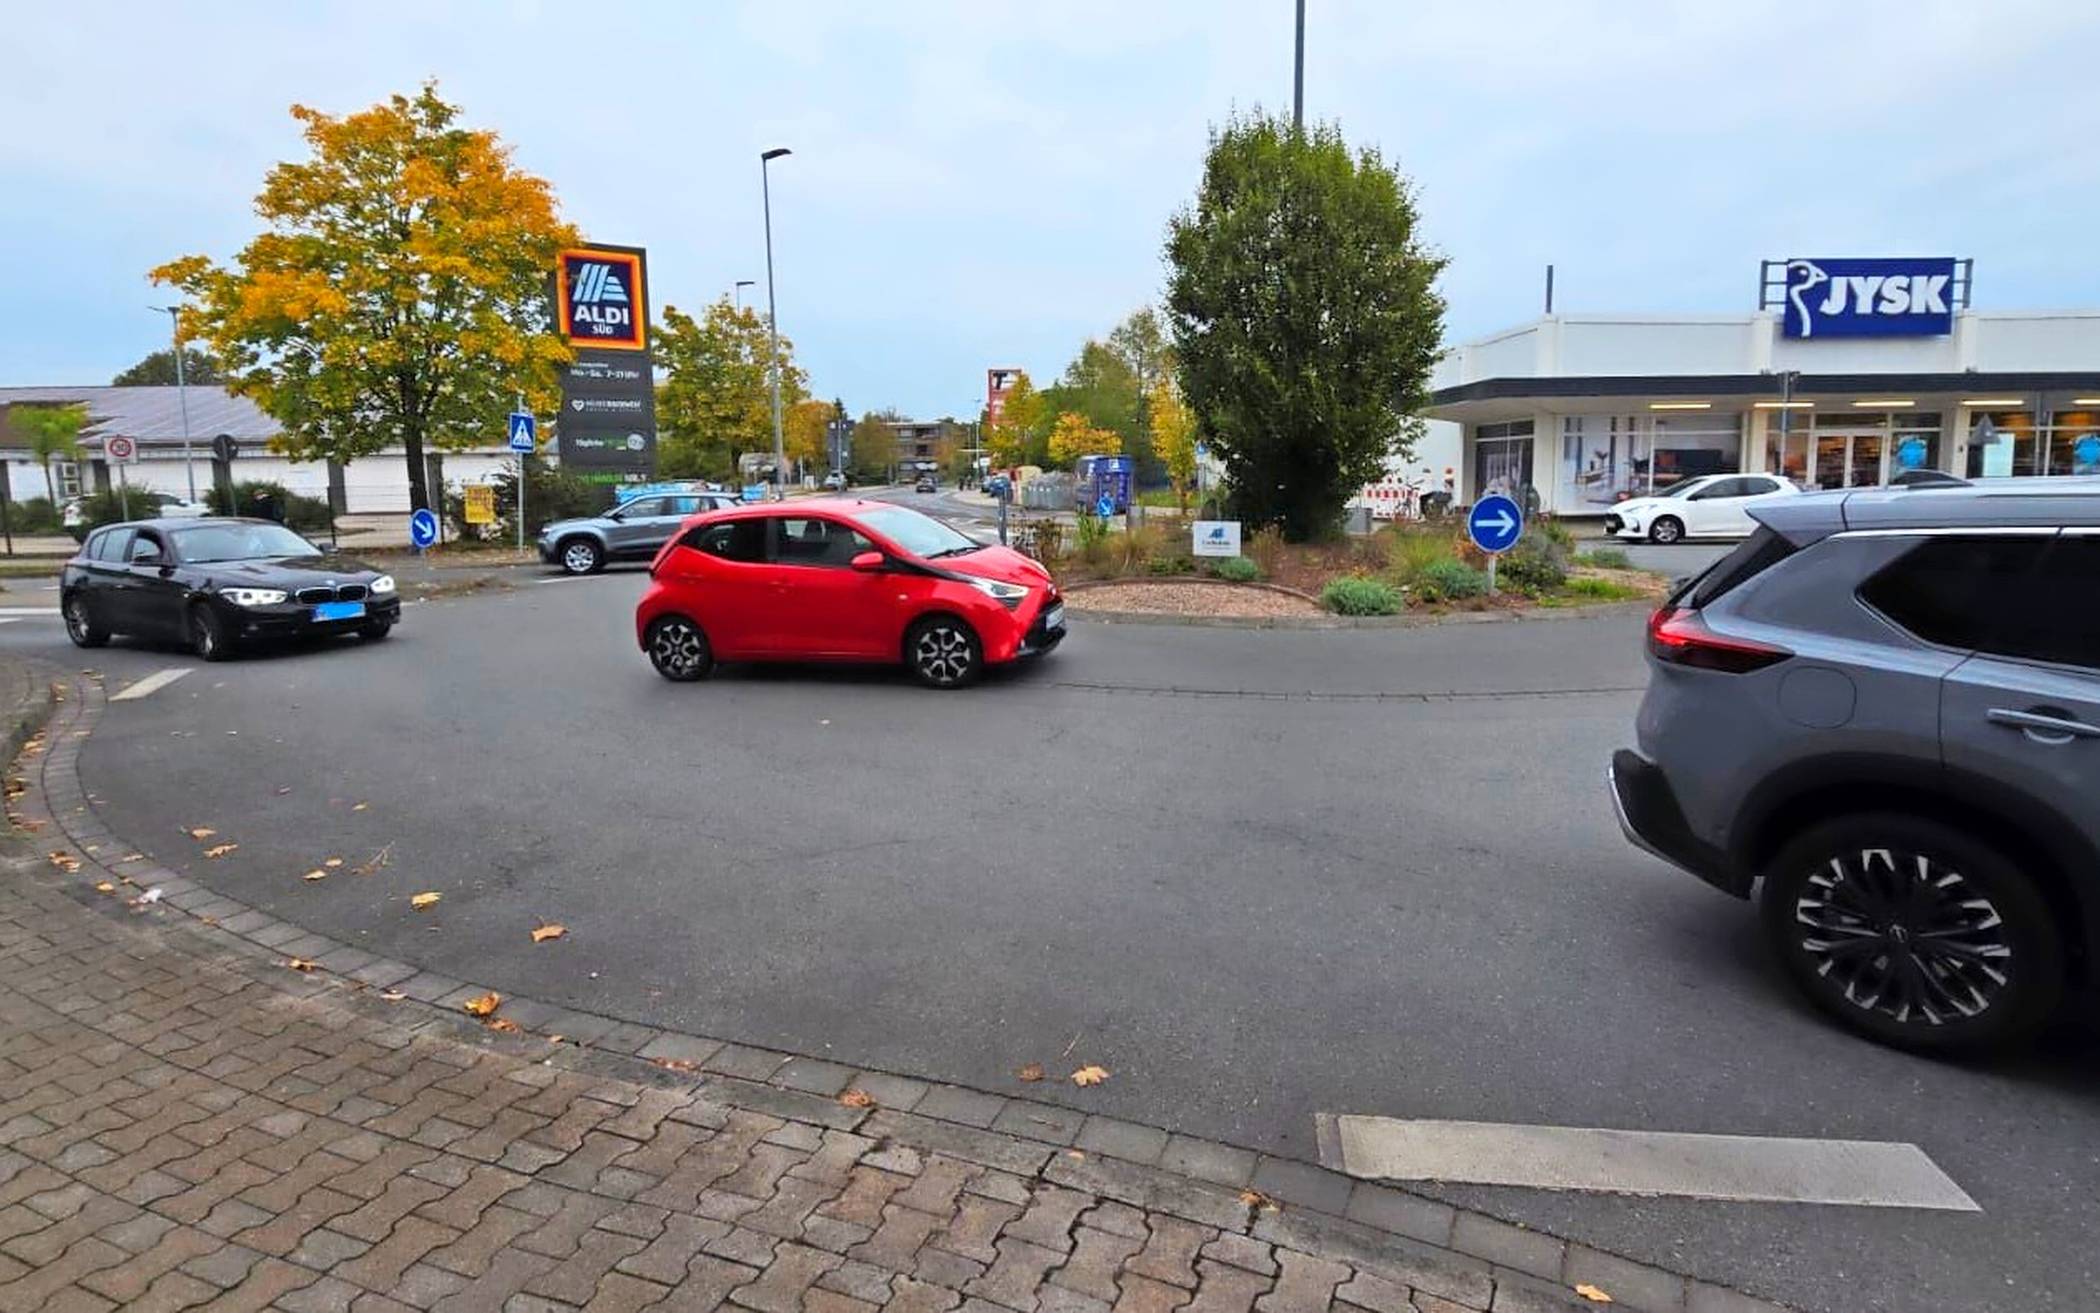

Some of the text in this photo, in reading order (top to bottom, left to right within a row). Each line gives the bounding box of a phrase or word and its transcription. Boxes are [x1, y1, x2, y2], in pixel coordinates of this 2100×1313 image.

[1819, 275, 1950, 315] JYSK
[574, 305, 629, 325] ALDI
[592, 322, 614, 335] SÜD
